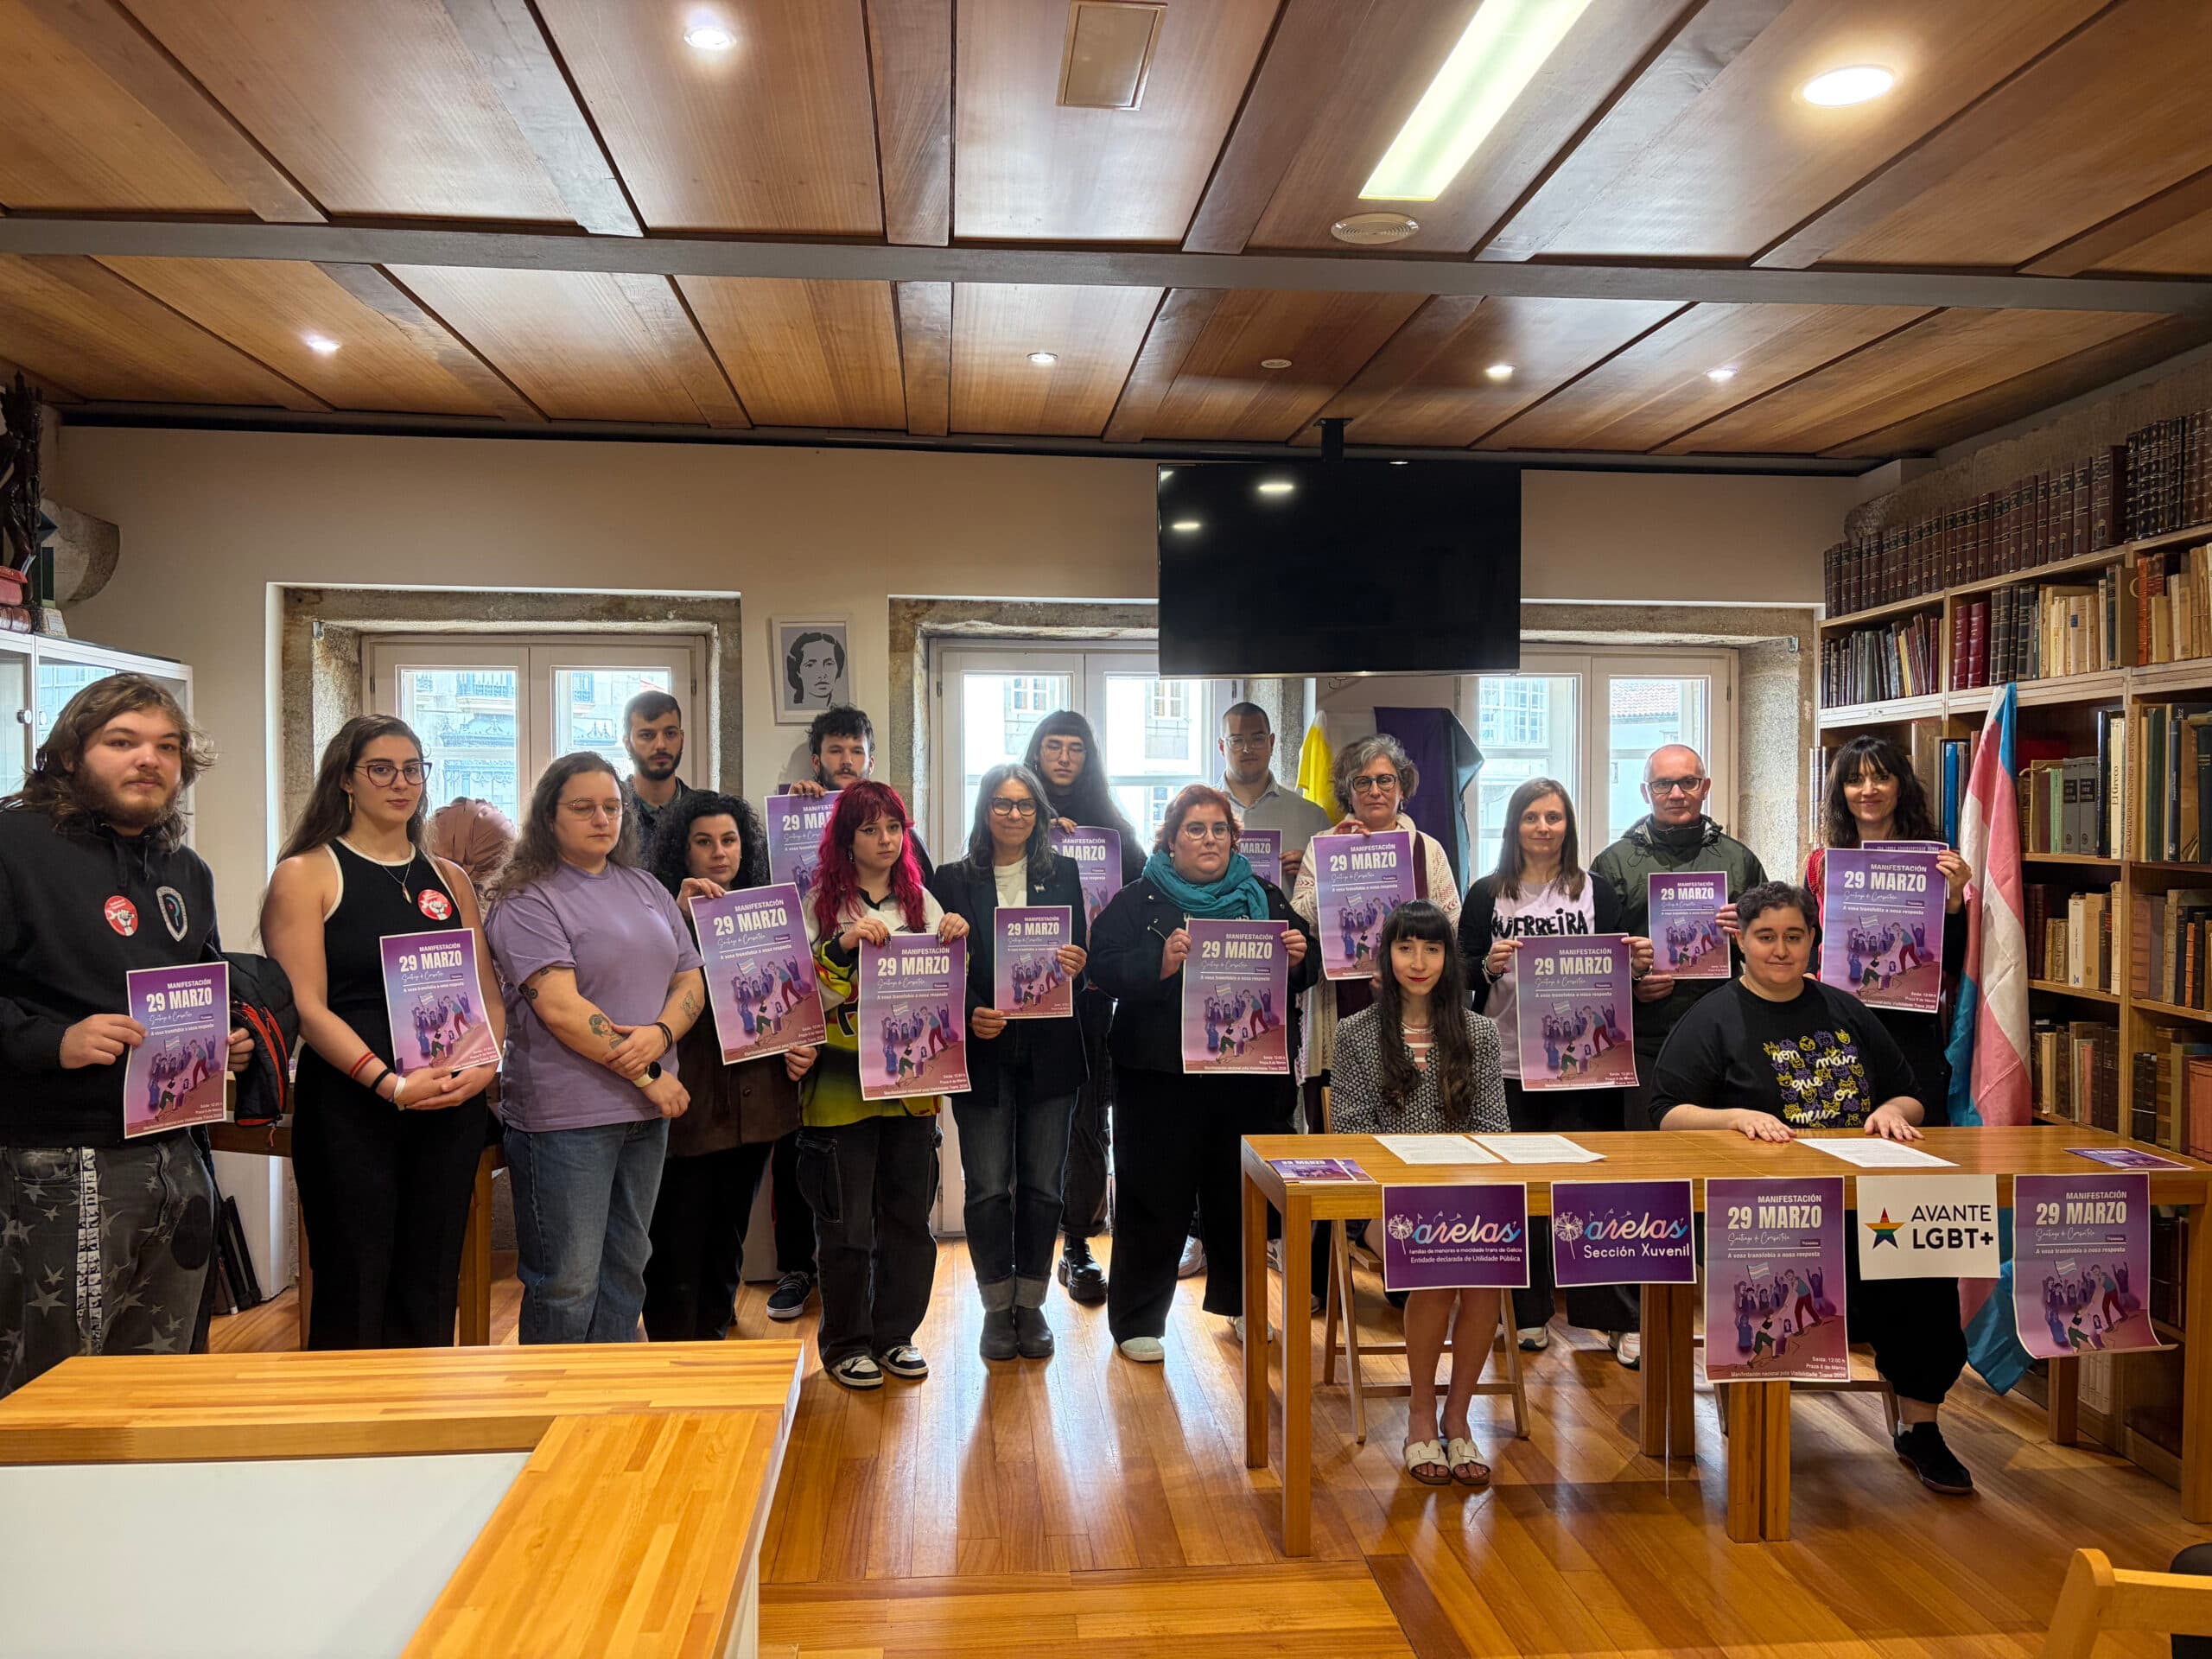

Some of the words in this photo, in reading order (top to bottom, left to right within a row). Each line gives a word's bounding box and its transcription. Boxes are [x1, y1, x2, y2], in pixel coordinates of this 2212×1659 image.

[782, 814, 799, 831] 29
[804, 811, 833, 830] MAR
[1063, 845, 1106, 861] MARZO
[1240, 842, 1270, 854] MARZO
[1351, 843, 1395, 852] MANIFESTACIÓN
[1330, 855, 1347, 872] 29
[1352, 852, 1397, 870] MARZO
[1844, 871, 1865, 888] 29
[1871, 873, 1926, 892] MARZO
[1661, 888, 1675, 900] 29
[1678, 887, 1714, 899] MARZO
[735, 899, 784, 912] MANIFESTACIÓN
[714, 916, 734, 937] 29
[738, 907, 787, 932] MARZO
[1007, 924, 1021, 936] 29
[1025, 923, 1059, 935] MARZO
[419, 943, 461, 952] MANIFESTACIÓN
[1202, 941, 1220, 958] 29
[1225, 942, 1272, 959] MARZO
[399, 955, 417, 972] 29
[421, 950, 462, 969] MARZO
[878, 957, 896, 976] 29
[902, 956, 949, 975] MARZO
[1535, 958, 1554, 976] 29
[1560, 957, 1611, 975] MARZO
[168, 978, 211, 989] MANIFESTACIÓN
[146, 993, 165, 1013] 29
[169, 988, 212, 1010] MARZO
[1792, 1077, 1822, 1096] que
[1790, 1109, 1840, 1123] meus
[1758, 1194, 1821, 1203] MANIFESTACIÓN
[2066, 1190, 2126, 1199] MANIFESTACIÓN
[1728, 1206, 1752, 1230] 29
[1759, 1205, 1821, 1229] MARZO
[1911, 1205, 1991, 1222] AVANTE
[2036, 1203, 2060, 1225] 29
[2066, 1202, 2126, 1224] MARZO
[1413, 1215, 1521, 1244] arelas
[1585, 1212, 1688, 1240] arelas
[1728, 1232, 1752, 1246] Santiago
[1913, 1228, 1993, 1249] LGBT+
[1584, 1245, 1635, 1258] Sección
[1642, 1243, 1689, 1256] Xuvenil
